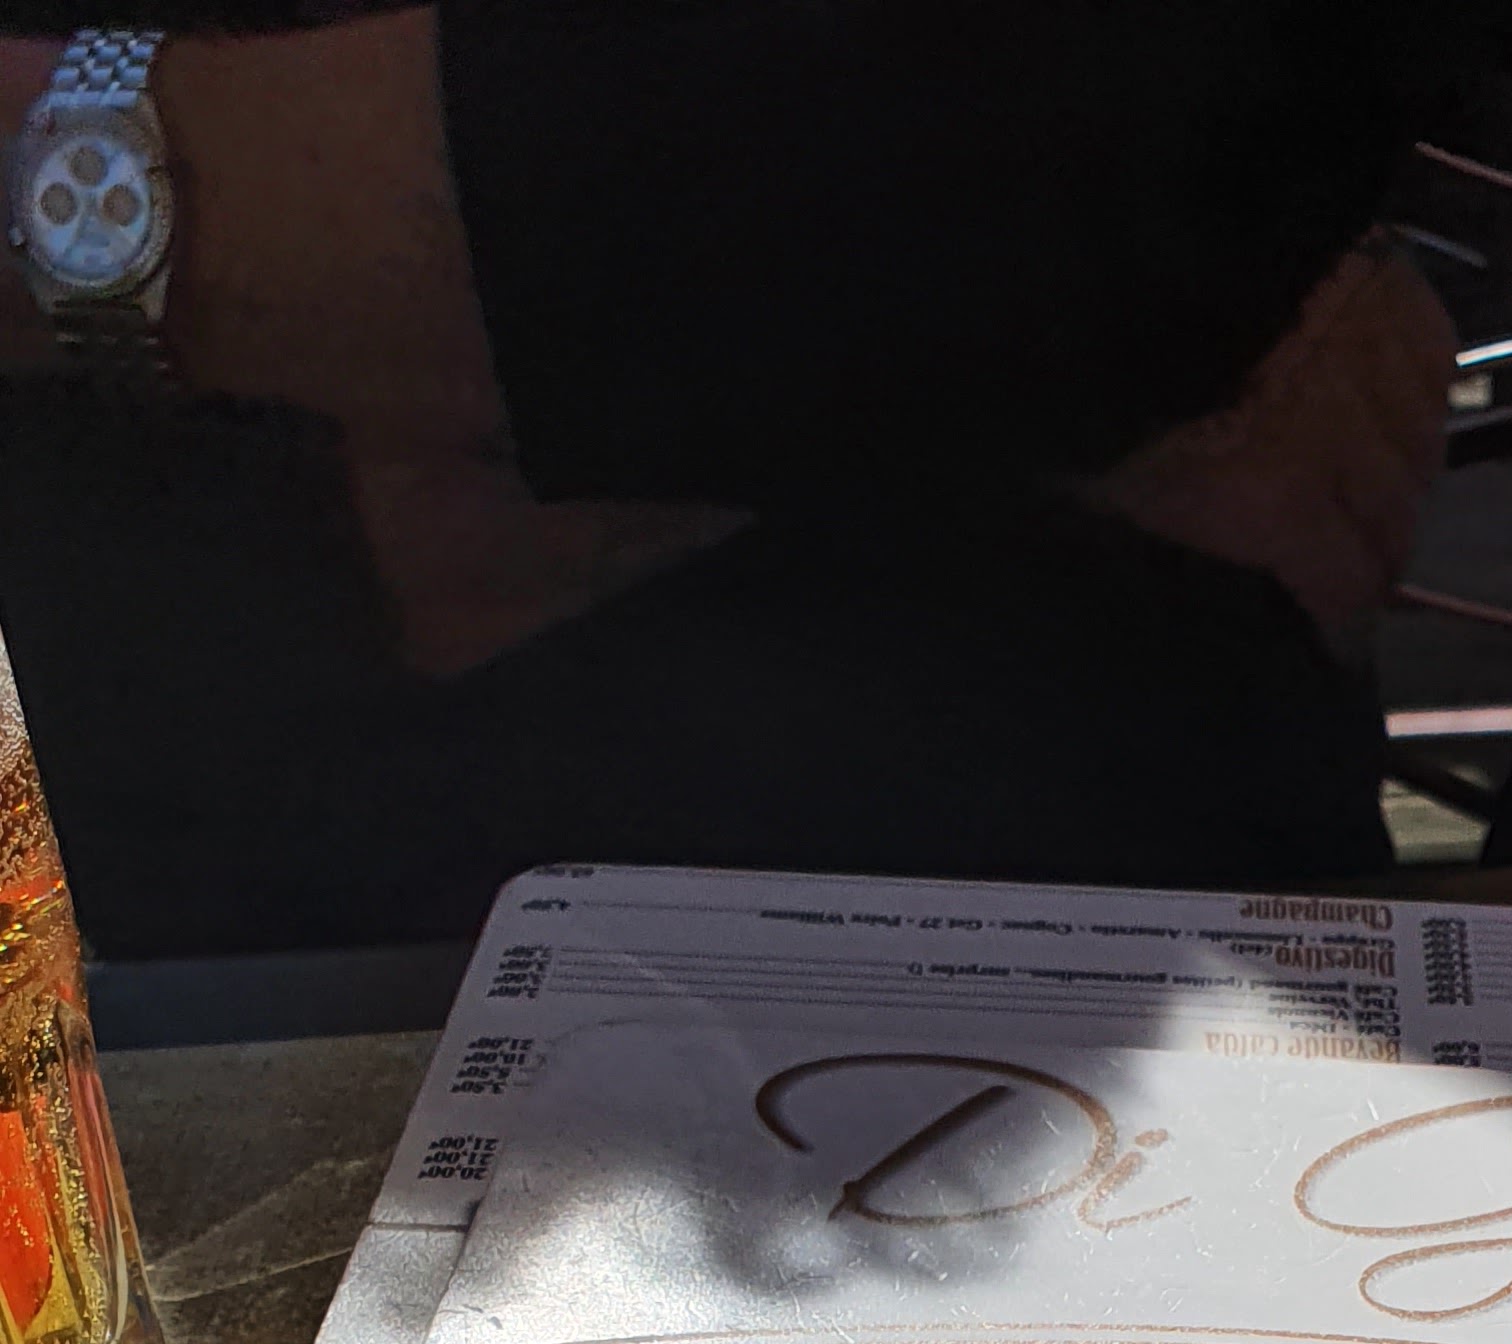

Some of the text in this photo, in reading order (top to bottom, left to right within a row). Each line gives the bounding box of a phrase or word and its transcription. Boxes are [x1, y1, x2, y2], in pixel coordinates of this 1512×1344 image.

[1239, 899, 1393, 932] Champagne
[1275, 946, 1395, 978] Digestivo
[756, 1053, 1192, 1232] Di
